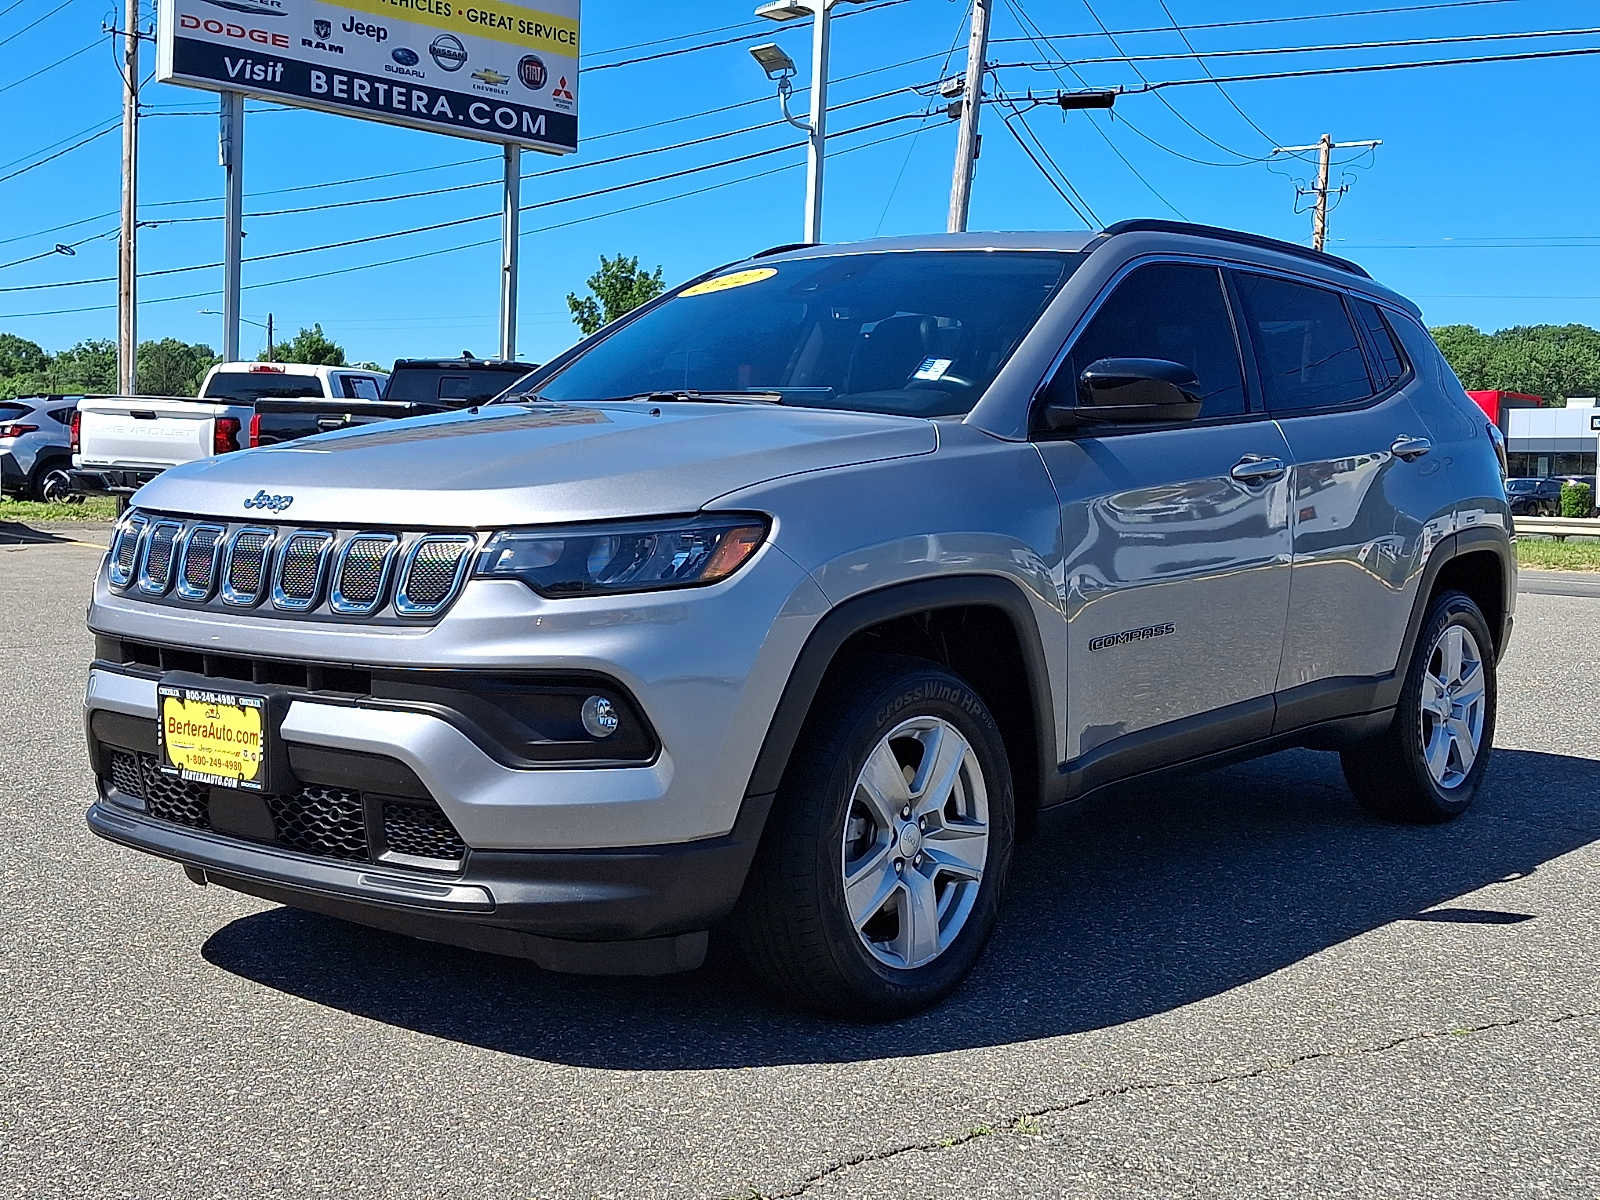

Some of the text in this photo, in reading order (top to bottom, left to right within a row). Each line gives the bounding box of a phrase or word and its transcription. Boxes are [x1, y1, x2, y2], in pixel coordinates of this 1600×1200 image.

[180, 14, 289, 48] DODGE
[342, 16, 387, 42] Jeep
[382, 0, 576, 46] HICLES GREAT SERVICE
[301, 38, 344, 54] RAM
[432, 46, 466, 60] NISSAN
[384, 64, 425, 79] SUBARU
[525, 64, 543, 83] FIAT
[223, 56, 547, 136] Visit BERTERA.COM
[472, 84, 509, 96] CHEVROLET
[244, 489, 294, 515] Jeep
[1088, 622, 1176, 652] COMPASS
[168, 717, 259, 747] BerteraAuto.com
[186, 754, 242, 772] 1-800-249-4980
